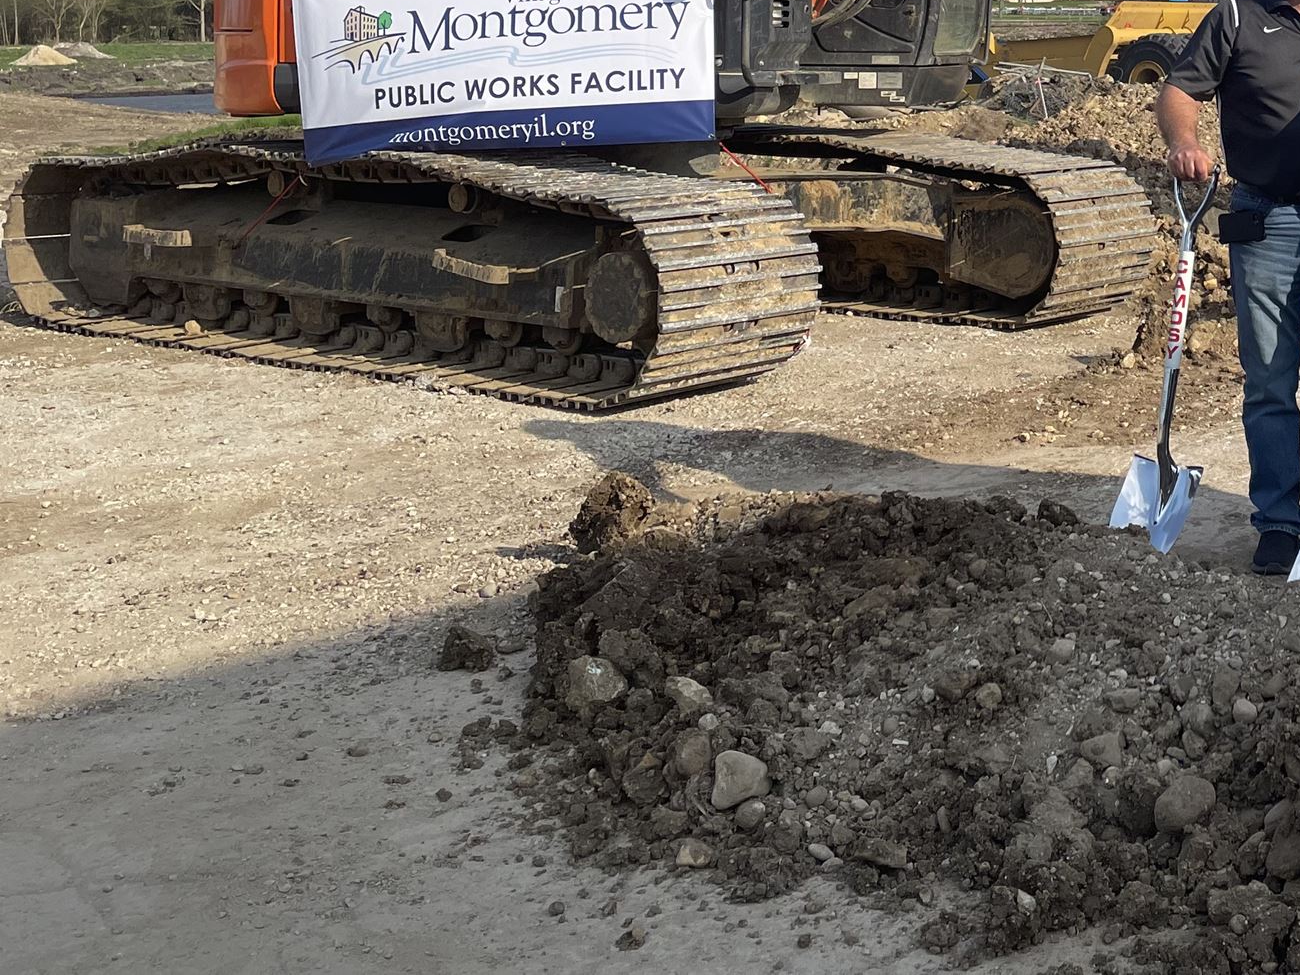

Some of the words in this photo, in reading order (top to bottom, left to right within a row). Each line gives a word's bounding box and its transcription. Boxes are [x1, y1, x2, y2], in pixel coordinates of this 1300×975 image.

[407, 0, 690, 55] Montgomery
[375, 81, 456, 110] PUBLIC
[464, 73, 560, 101] WORKS
[570, 67, 686, 95] FACILITY
